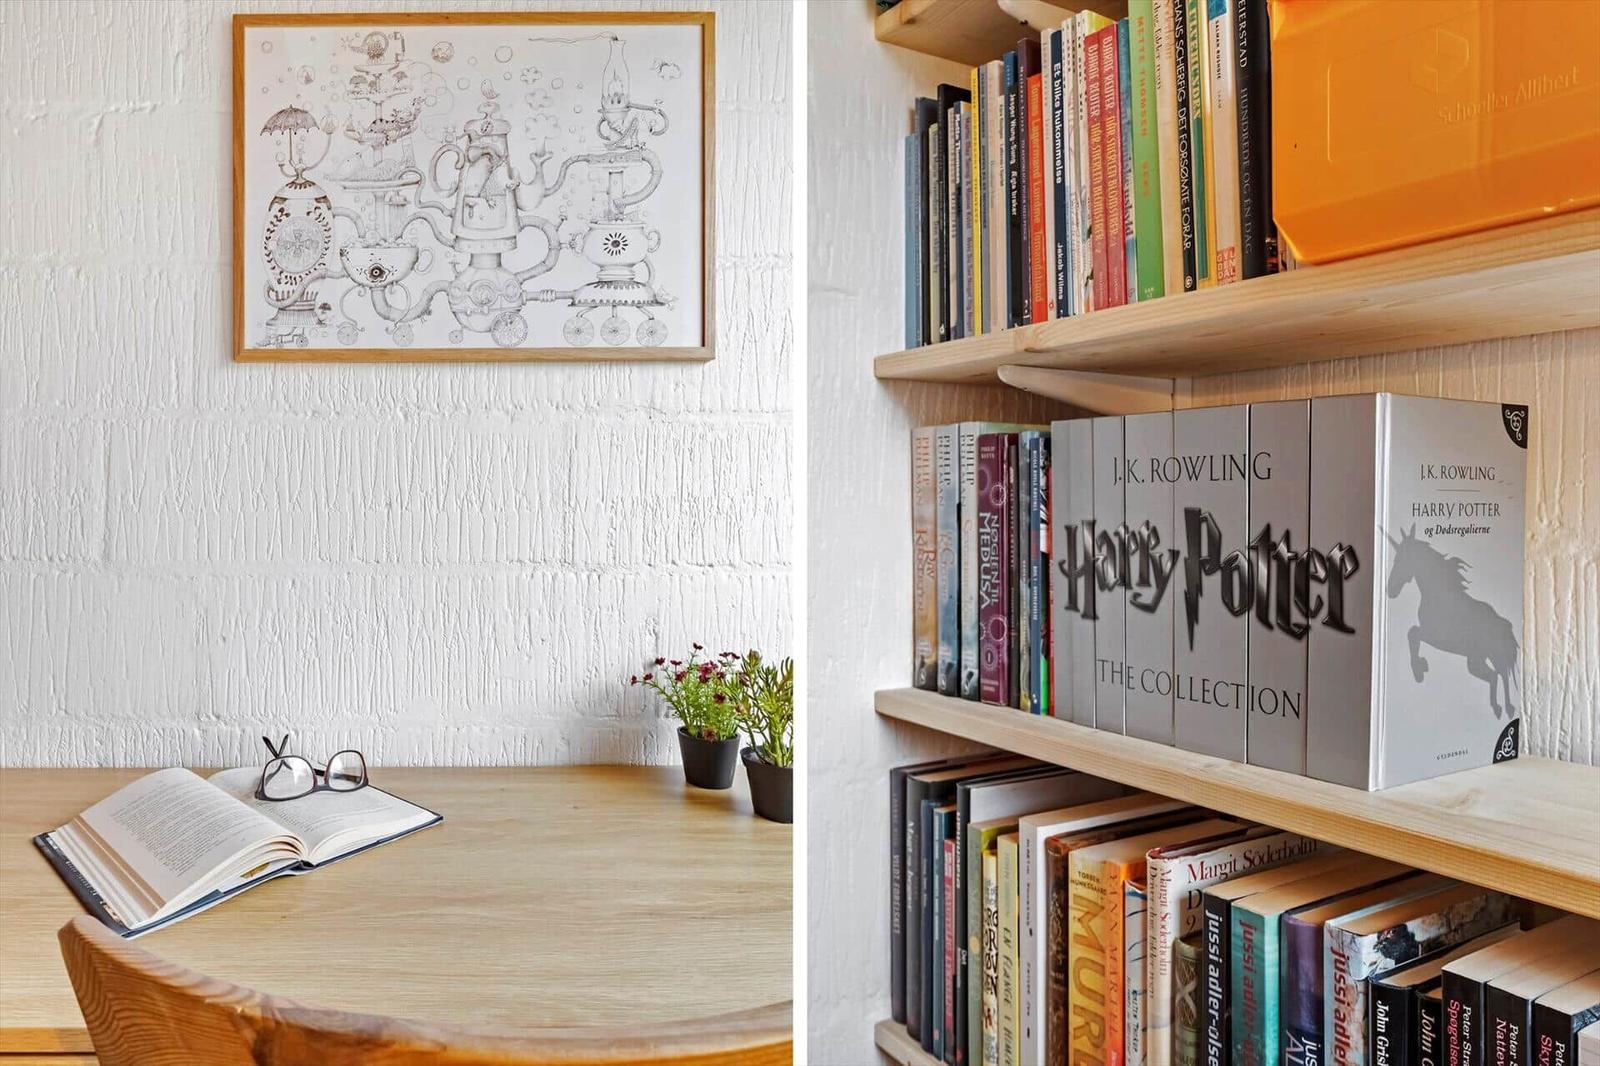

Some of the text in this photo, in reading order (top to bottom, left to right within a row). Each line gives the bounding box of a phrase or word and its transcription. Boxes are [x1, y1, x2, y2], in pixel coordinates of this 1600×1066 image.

[1174, 0, 1185, 38] HANS
[1053, 62, 1061, 77] Et
[1175, 41, 1187, 103] SCHERFIG
[1437, 65, 1581, 125] Schoeller Allibert
[1178, 107, 1188, 131] DET
[1054, 110, 1064, 184] hukommelse
[1179, 134, 1190, 201] FORSØMTE
[1113, 452, 1272, 486] J.K. ROWLING
[1440, 465, 1496, 481] ROWLING
[1412, 502, 1501, 519] HARRY POTTER
[1424, 528, 1434, 538] og
[979, 511, 991, 609] MEDUSA
[1058, 519, 1181, 621] Harry
[1184, 507, 1360, 651] Potter
[1097, 659, 1301, 719] THE COLLECTION
[1188, 854, 1237, 884] Margit
[1206, 909, 1223, 962] jussi
[1240, 919, 1258, 974] jussi
[1331, 947, 1351, 1009] jussi
[1376, 1000, 1389, 1033] John
[1422, 1009, 1436, 1053] John
[1462, 1004, 1473, 1039] Peter
[1509, 1023, 1519, 1059] Peter
